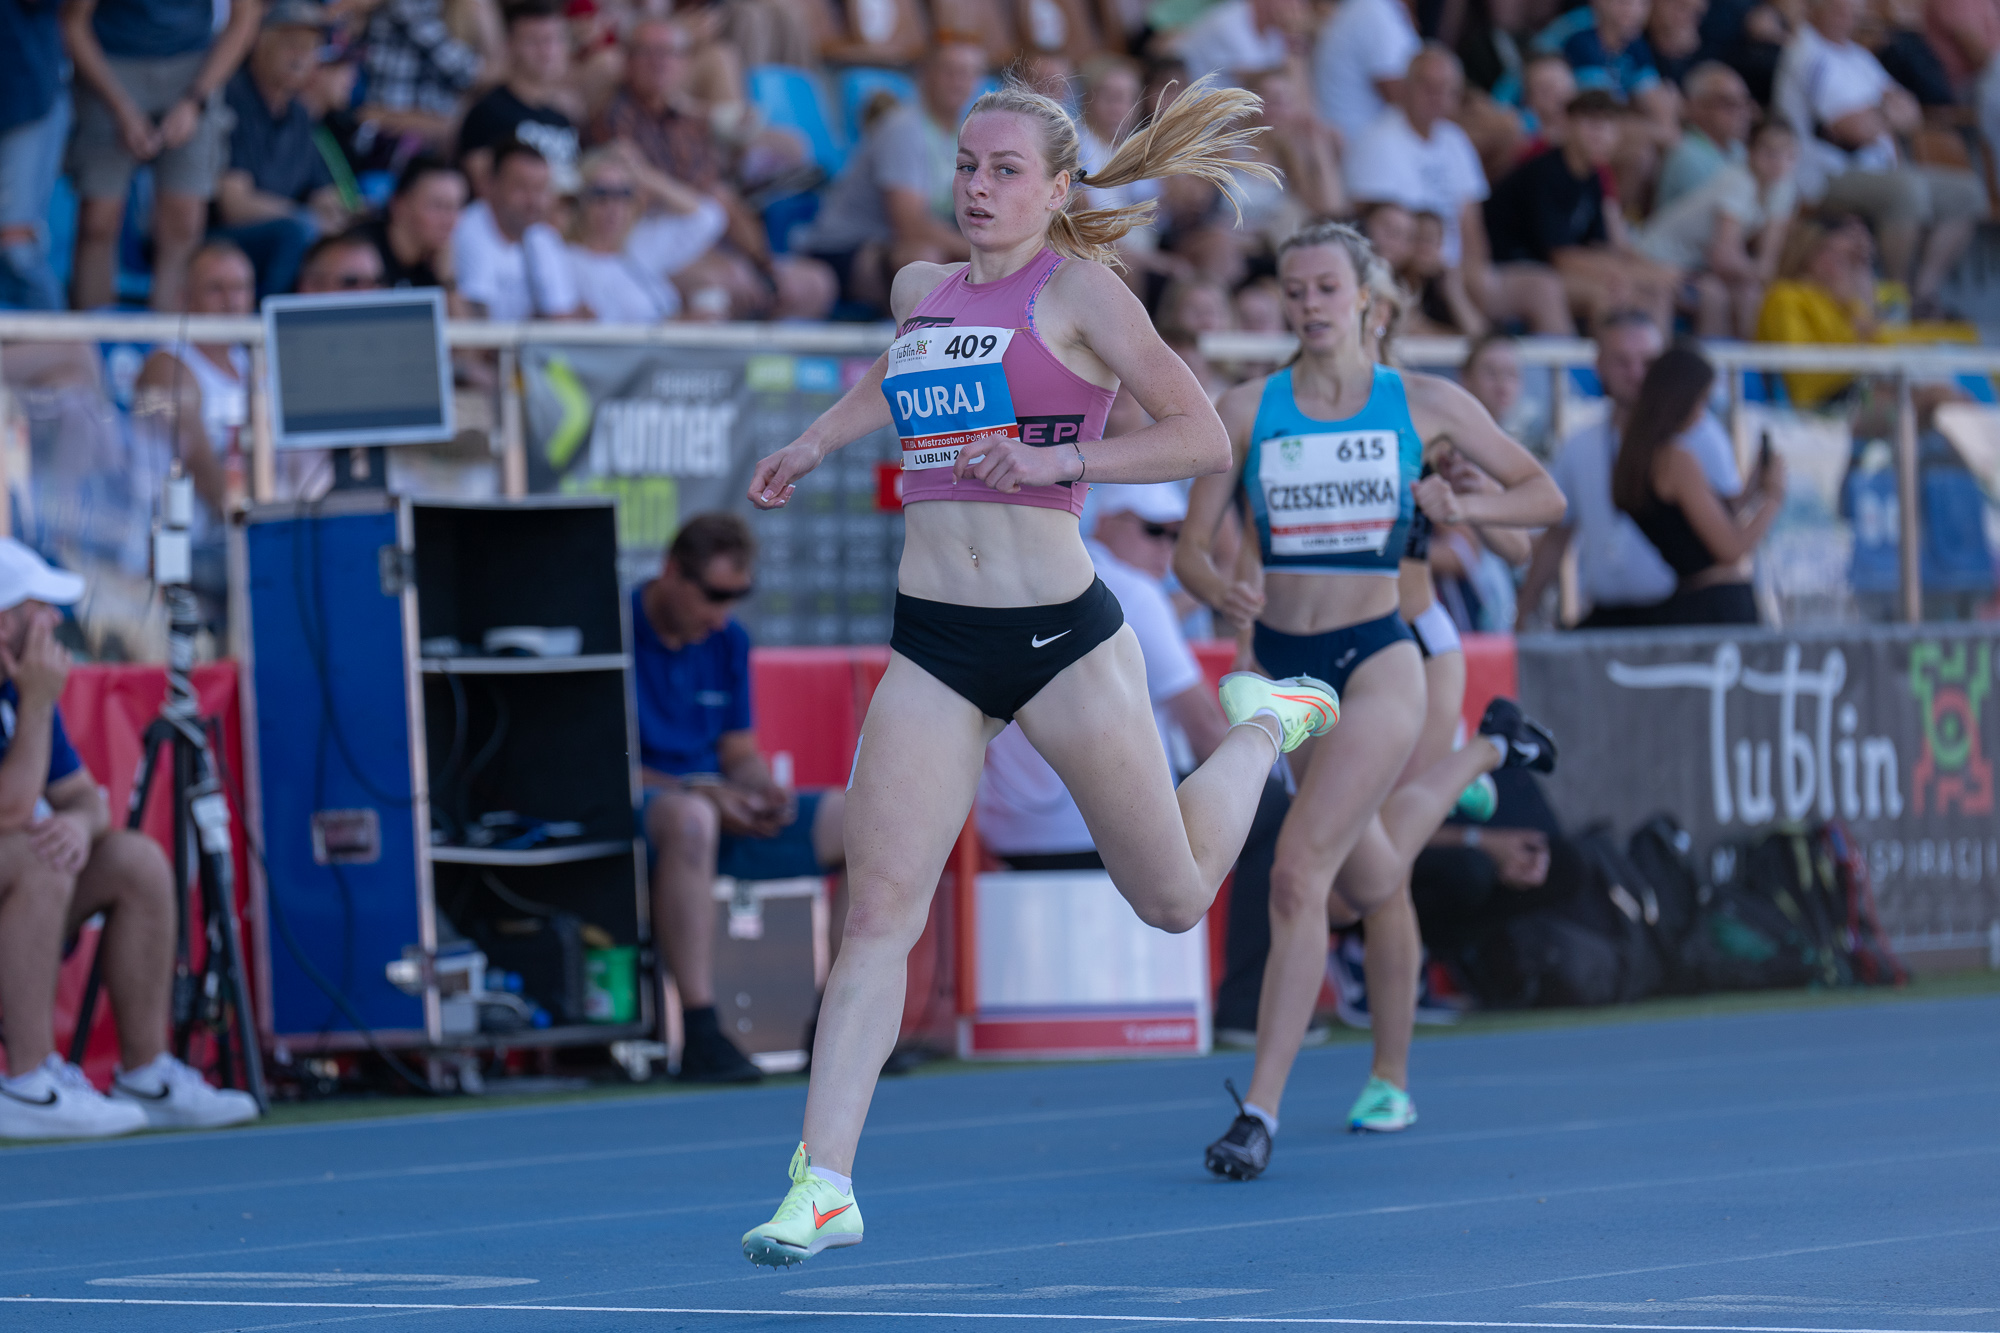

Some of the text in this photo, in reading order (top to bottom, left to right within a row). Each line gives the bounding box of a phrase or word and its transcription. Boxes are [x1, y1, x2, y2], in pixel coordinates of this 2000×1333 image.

[944, 334, 998, 360] 409
[896, 381, 986, 421] DURAJ
[917, 435, 965, 448] Mistrzostwa
[966, 431, 989, 443] Polski
[1336, 437, 1385, 462] 615
[914, 451, 951, 465] LUBLIN
[1269, 478, 1396, 511] CZESZEWSKA
[1605, 641, 1905, 826] Lublin
